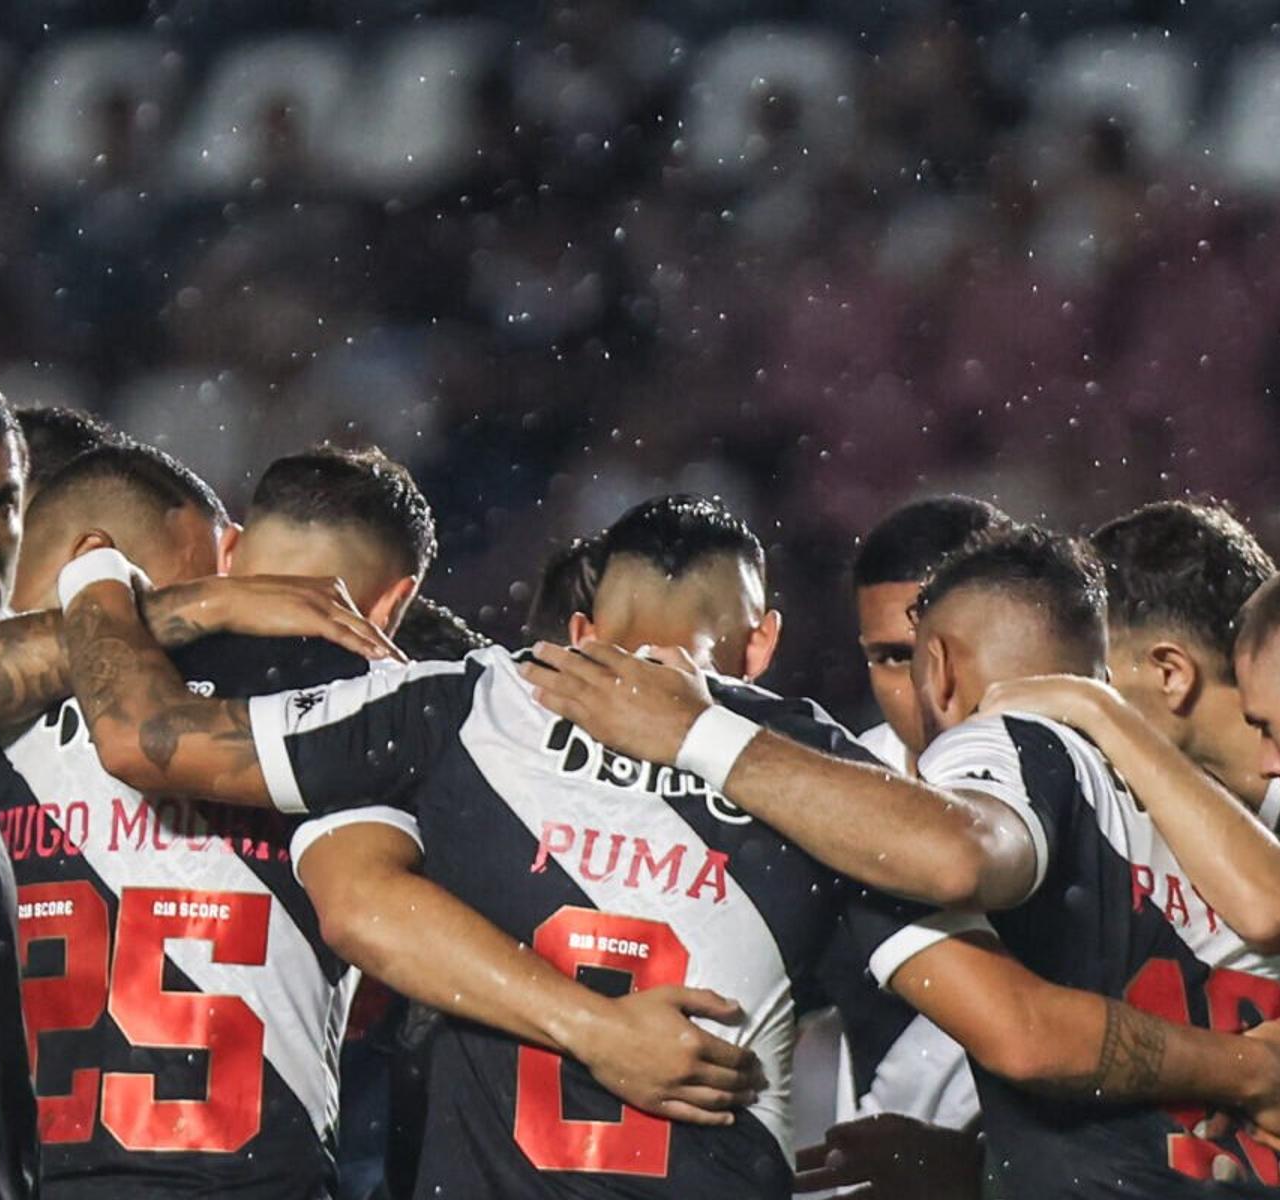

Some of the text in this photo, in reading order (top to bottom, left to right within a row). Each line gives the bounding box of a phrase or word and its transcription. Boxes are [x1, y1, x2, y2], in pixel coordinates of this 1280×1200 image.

[531, 821, 731, 904] PUMA
[179, 902, 231, 919] SCORE
[597, 936, 650, 959] SCORE
[18, 881, 272, 1153] 25
